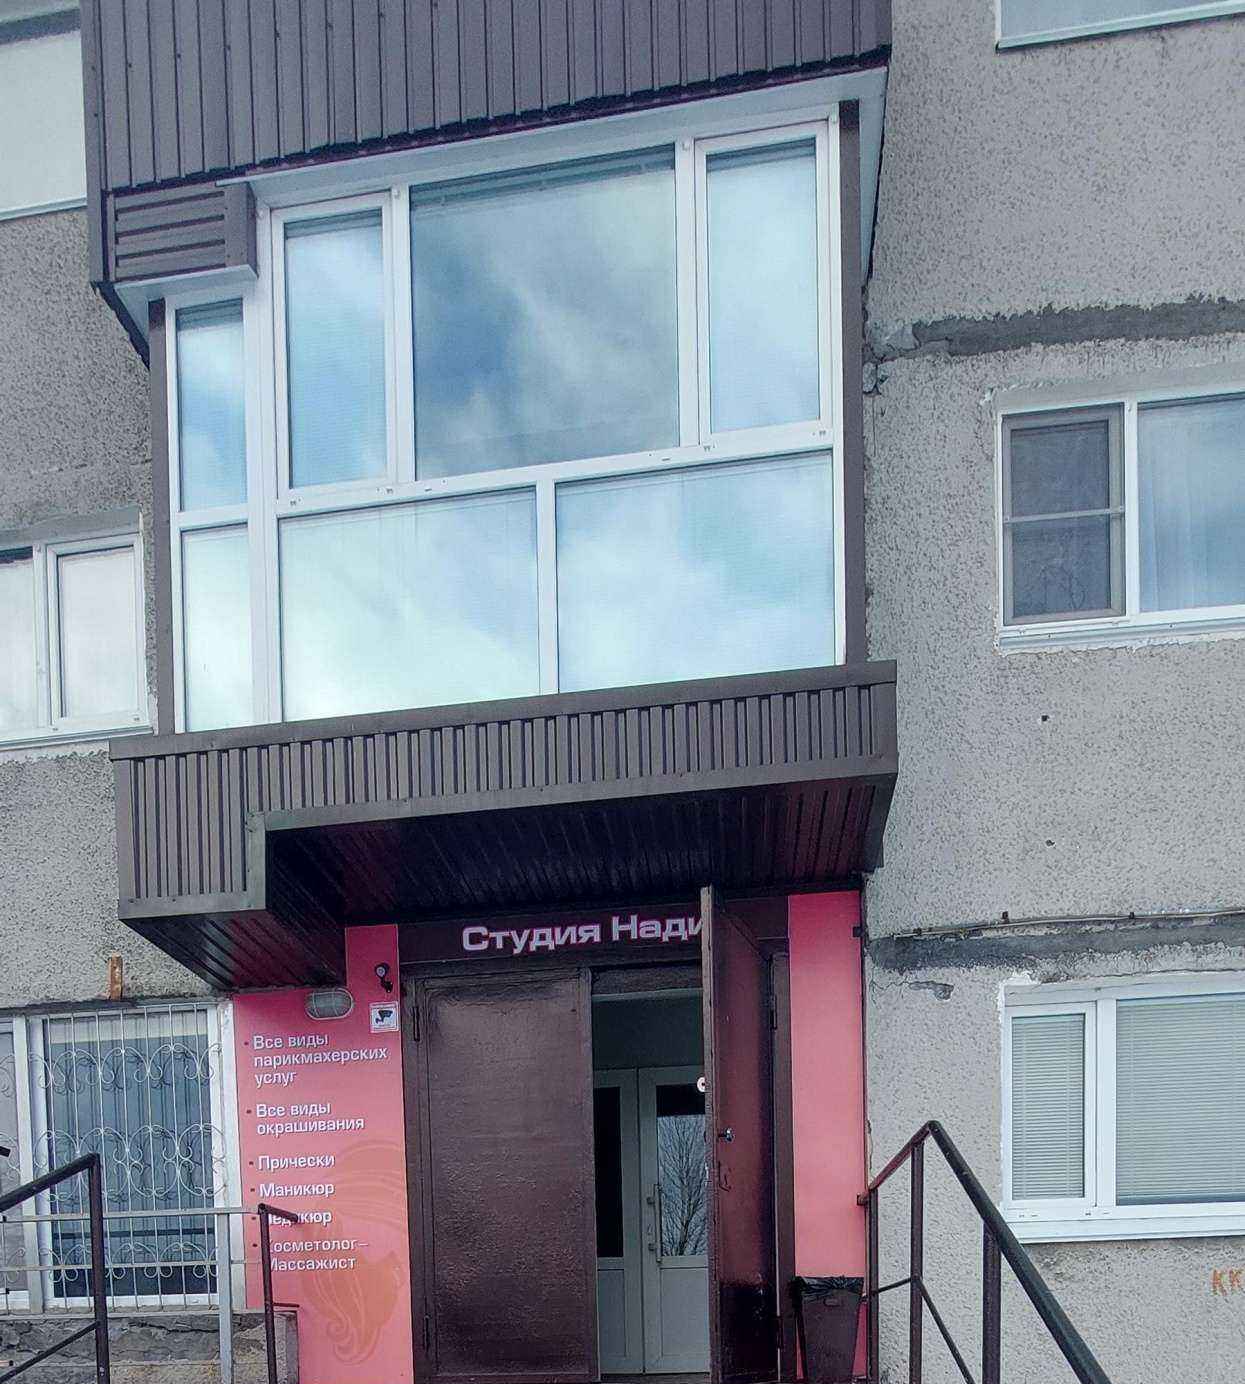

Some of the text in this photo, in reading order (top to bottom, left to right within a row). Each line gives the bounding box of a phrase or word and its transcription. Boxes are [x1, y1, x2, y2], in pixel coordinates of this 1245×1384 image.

[462, 925, 601, 954] Студия
[253, 1034, 329, 1050] Все виды
[254, 1047, 388, 1068] парикмахерских
[254, 1072, 297, 1088] услуг
[256, 1102, 331, 1117] Все виды
[256, 1118, 366, 1138] окрашивания
[258, 1155, 336, 1173] Прически
[259, 1183, 336, 1200] Маникюр
